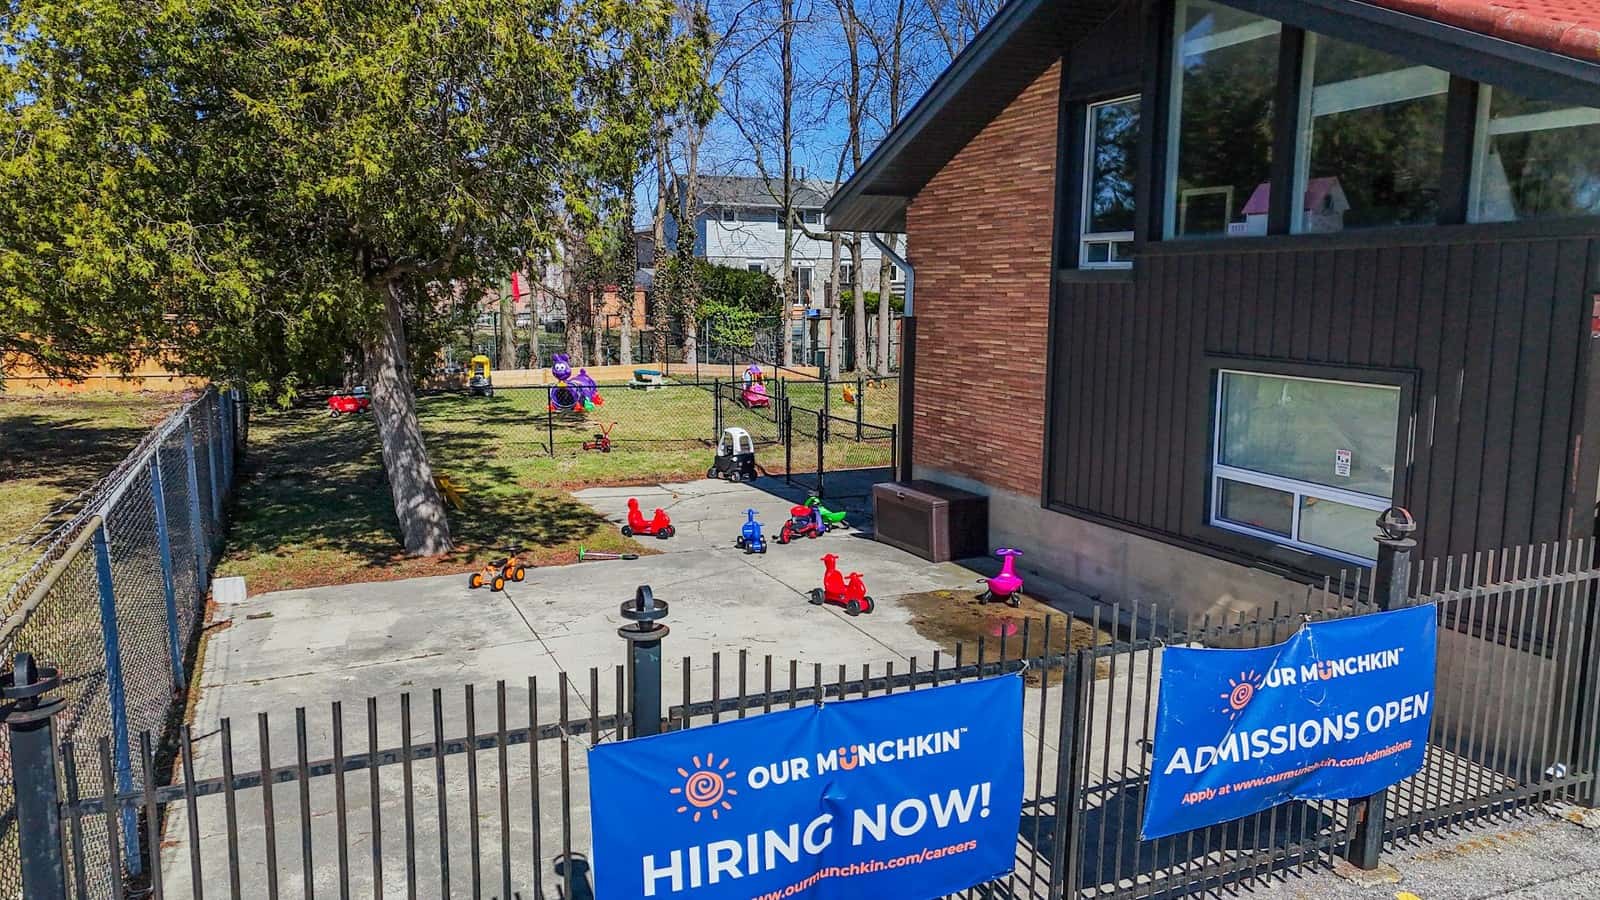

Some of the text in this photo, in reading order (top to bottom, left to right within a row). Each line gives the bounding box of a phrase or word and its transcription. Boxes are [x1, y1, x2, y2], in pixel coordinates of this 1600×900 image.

[1257, 666, 1297, 690] UR
[1164, 691, 1430, 775] ADMISSIONS OPEN
[747, 757, 810, 790] OUR
[1181, 787, 1217, 804] Apply
[1218, 783, 1231, 795] at
[642, 782, 991, 897] HIRING NOW!
[751, 839, 977, 900] ww.ourmunchkin.com/careers
